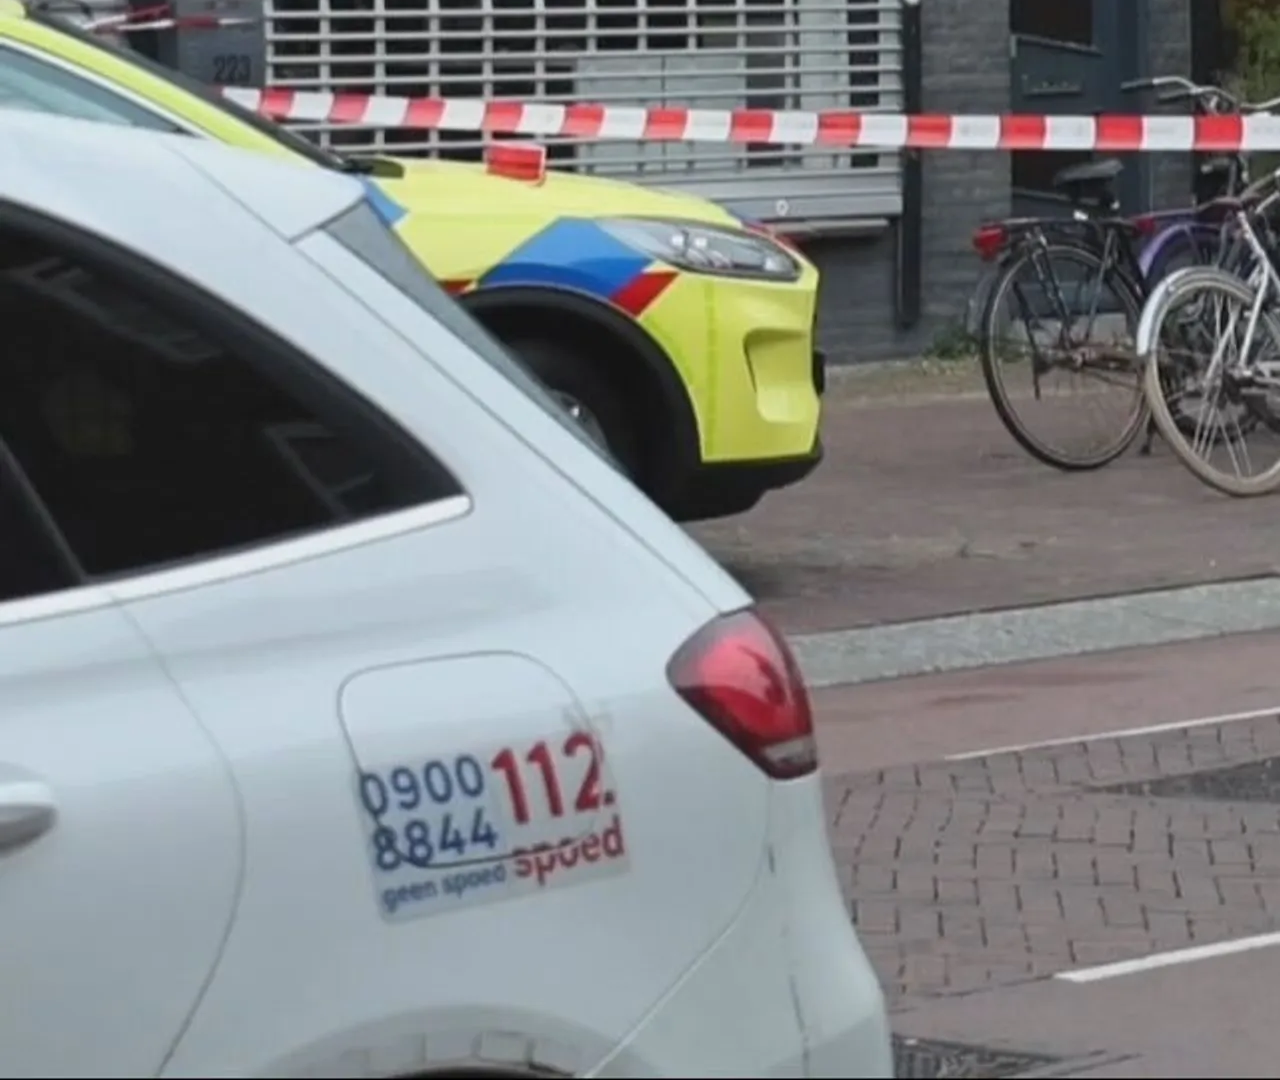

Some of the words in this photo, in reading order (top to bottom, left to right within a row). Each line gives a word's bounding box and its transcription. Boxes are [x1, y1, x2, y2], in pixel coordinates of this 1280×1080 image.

[212, 52, 251, 86] 223
[360, 754, 485, 816] 0900
[373, 806, 498, 871] 8844
[512, 814, 626, 887] spoed
[381, 879, 438, 913] geen
[441, 864, 507, 899] spoed
